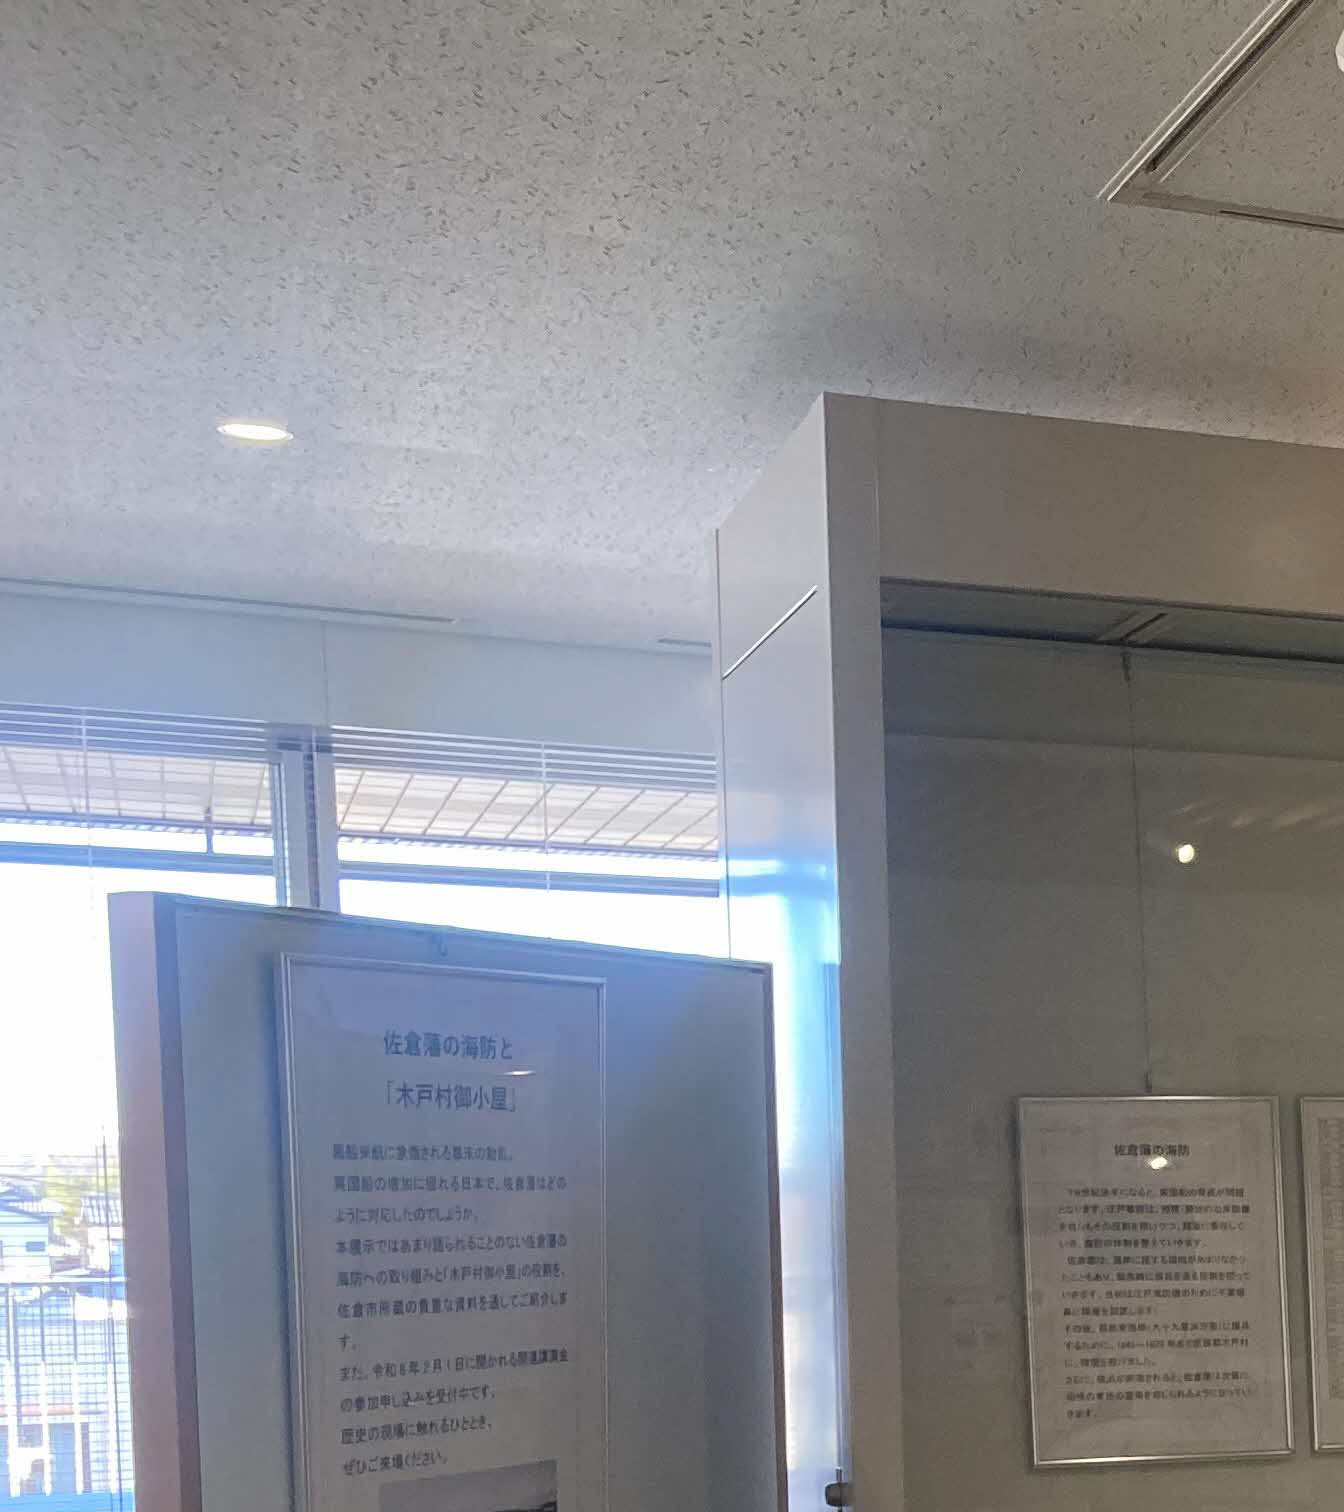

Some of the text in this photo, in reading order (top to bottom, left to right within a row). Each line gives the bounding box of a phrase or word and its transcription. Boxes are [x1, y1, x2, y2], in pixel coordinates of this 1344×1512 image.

[384, 1030, 513, 1060] 佐倉藩の海防と
[385, 1081, 517, 1112] 「木戸村御小屋」
